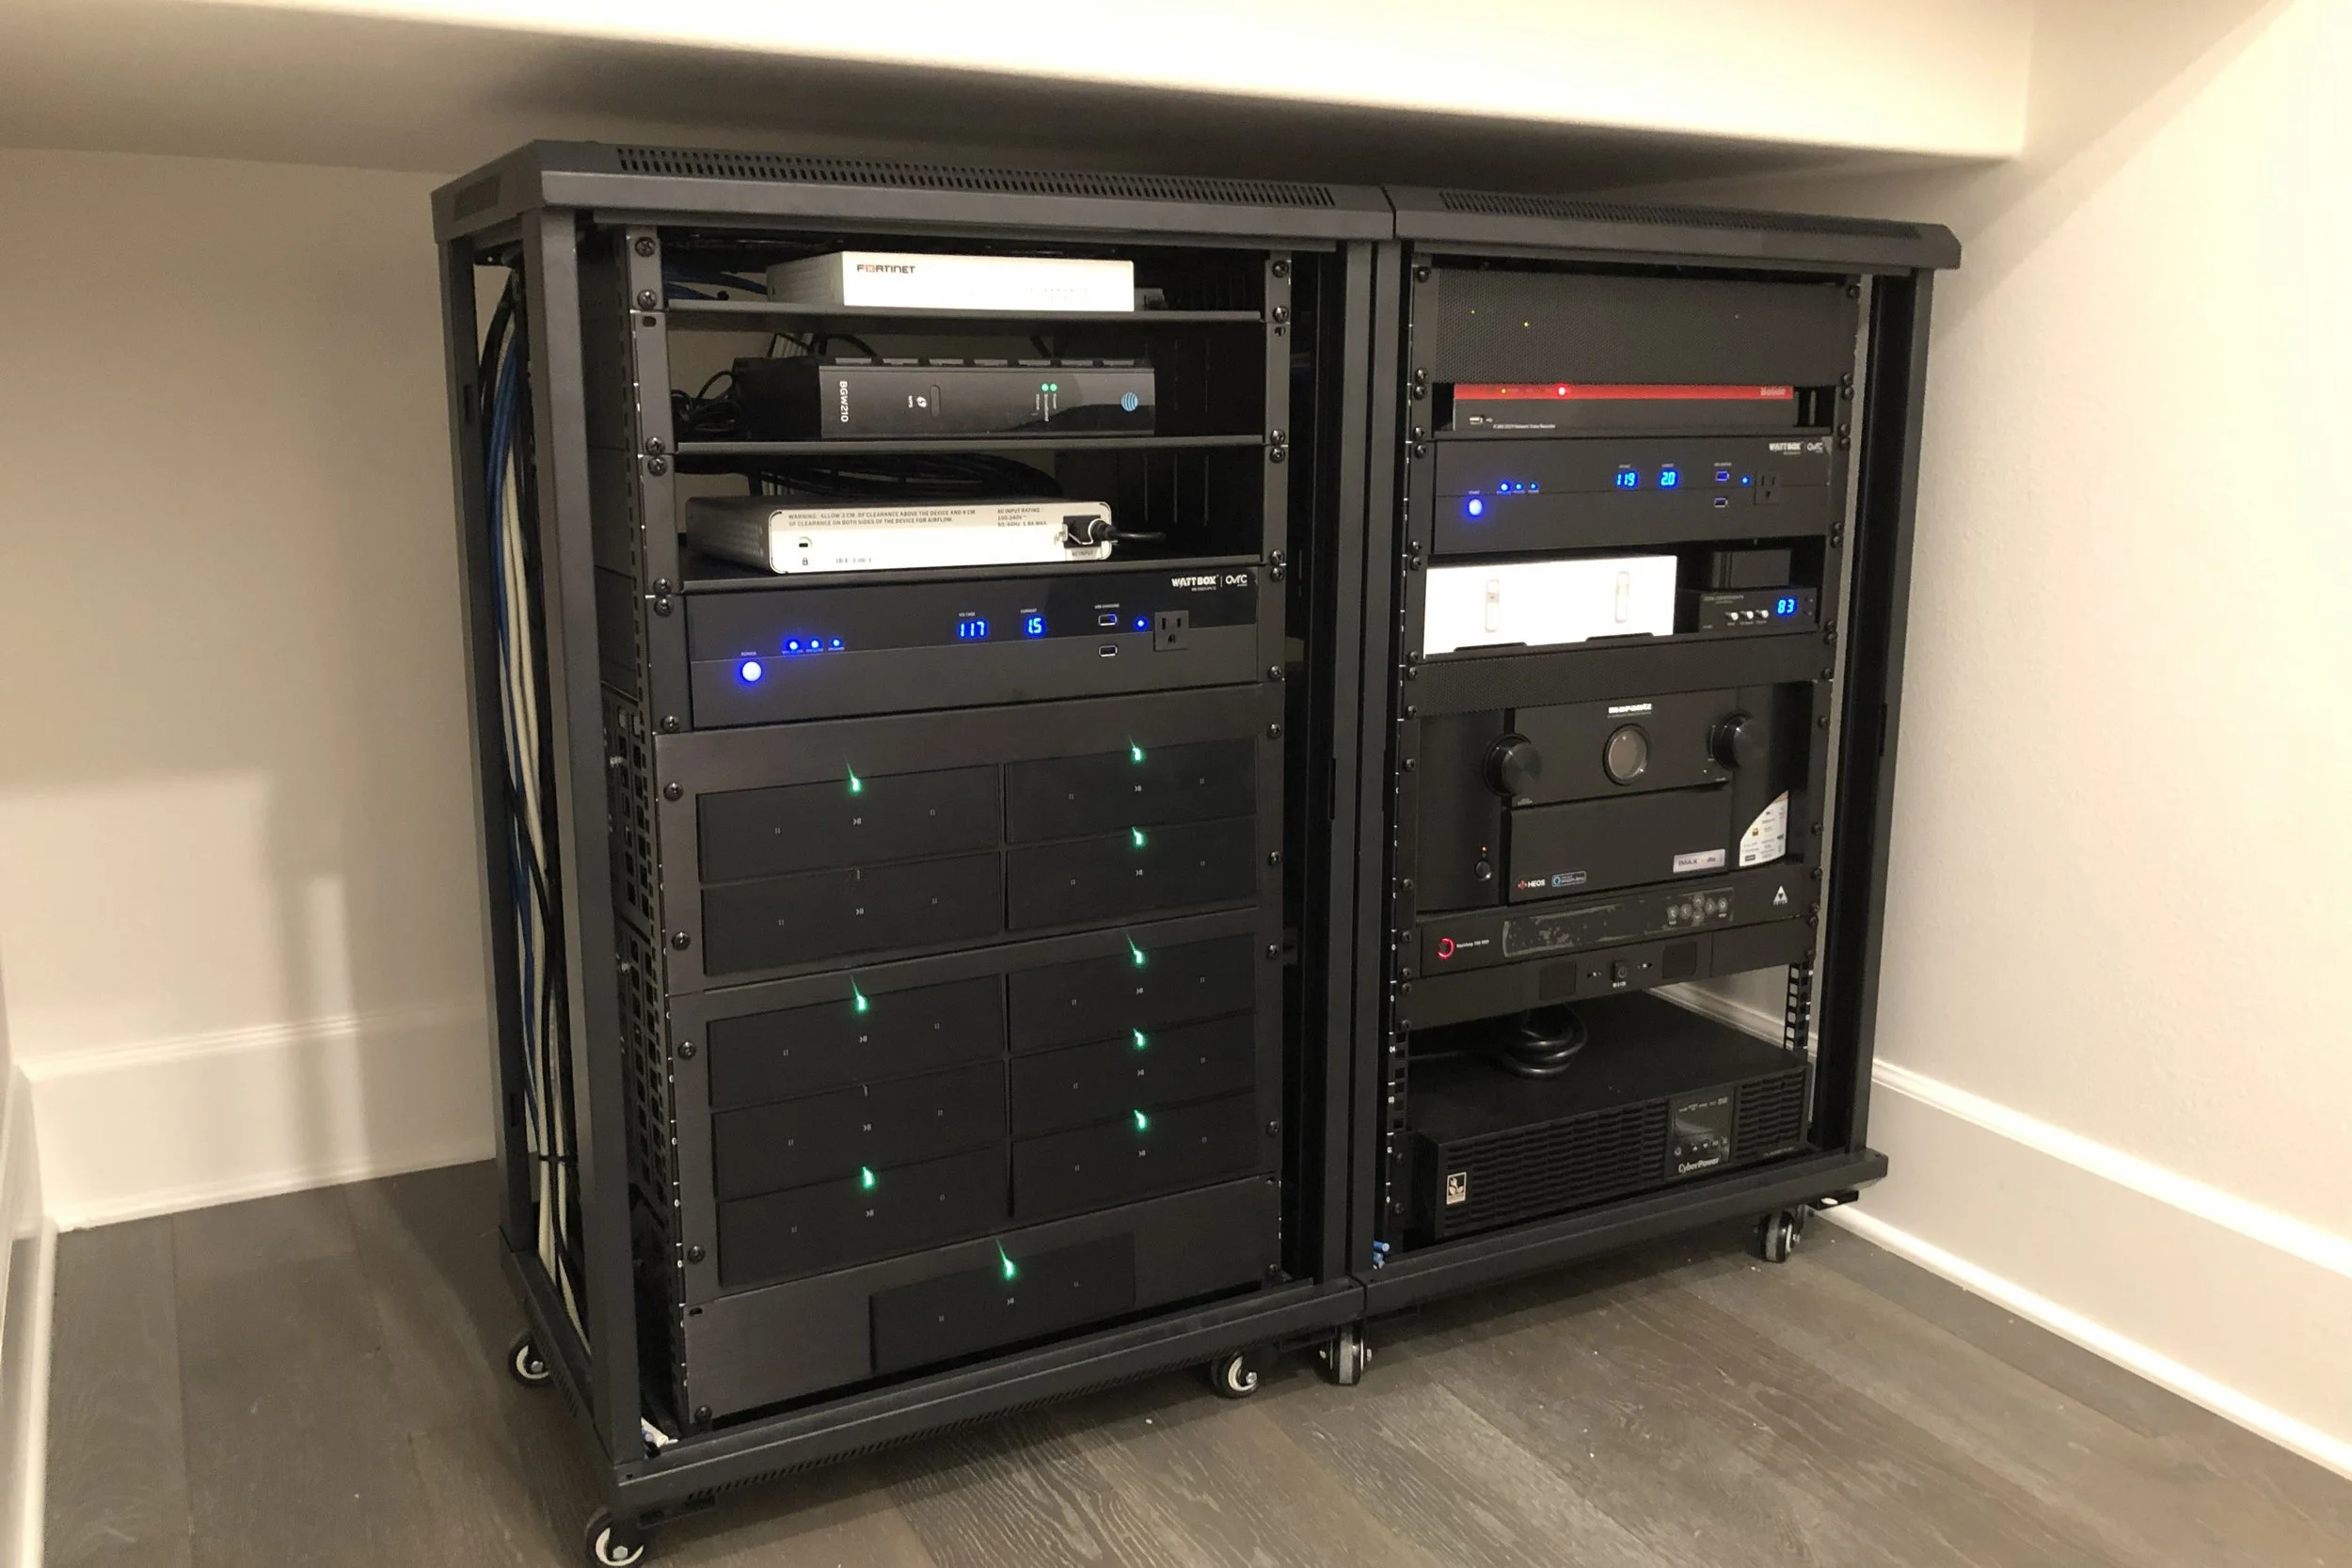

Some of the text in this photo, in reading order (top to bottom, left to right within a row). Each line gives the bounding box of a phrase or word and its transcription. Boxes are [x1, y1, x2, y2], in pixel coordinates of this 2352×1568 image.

[856, 264, 916, 274] FORTINET
[839, 380, 850, 422] BGW210
[1616, 472, 1635, 486] 119
[1777, 598, 1795, 614] 83
[960, 622, 985, 637] 117
[1527, 879, 1546, 888] HEOS
[1678, 1157, 1720, 1174] CyberPower
